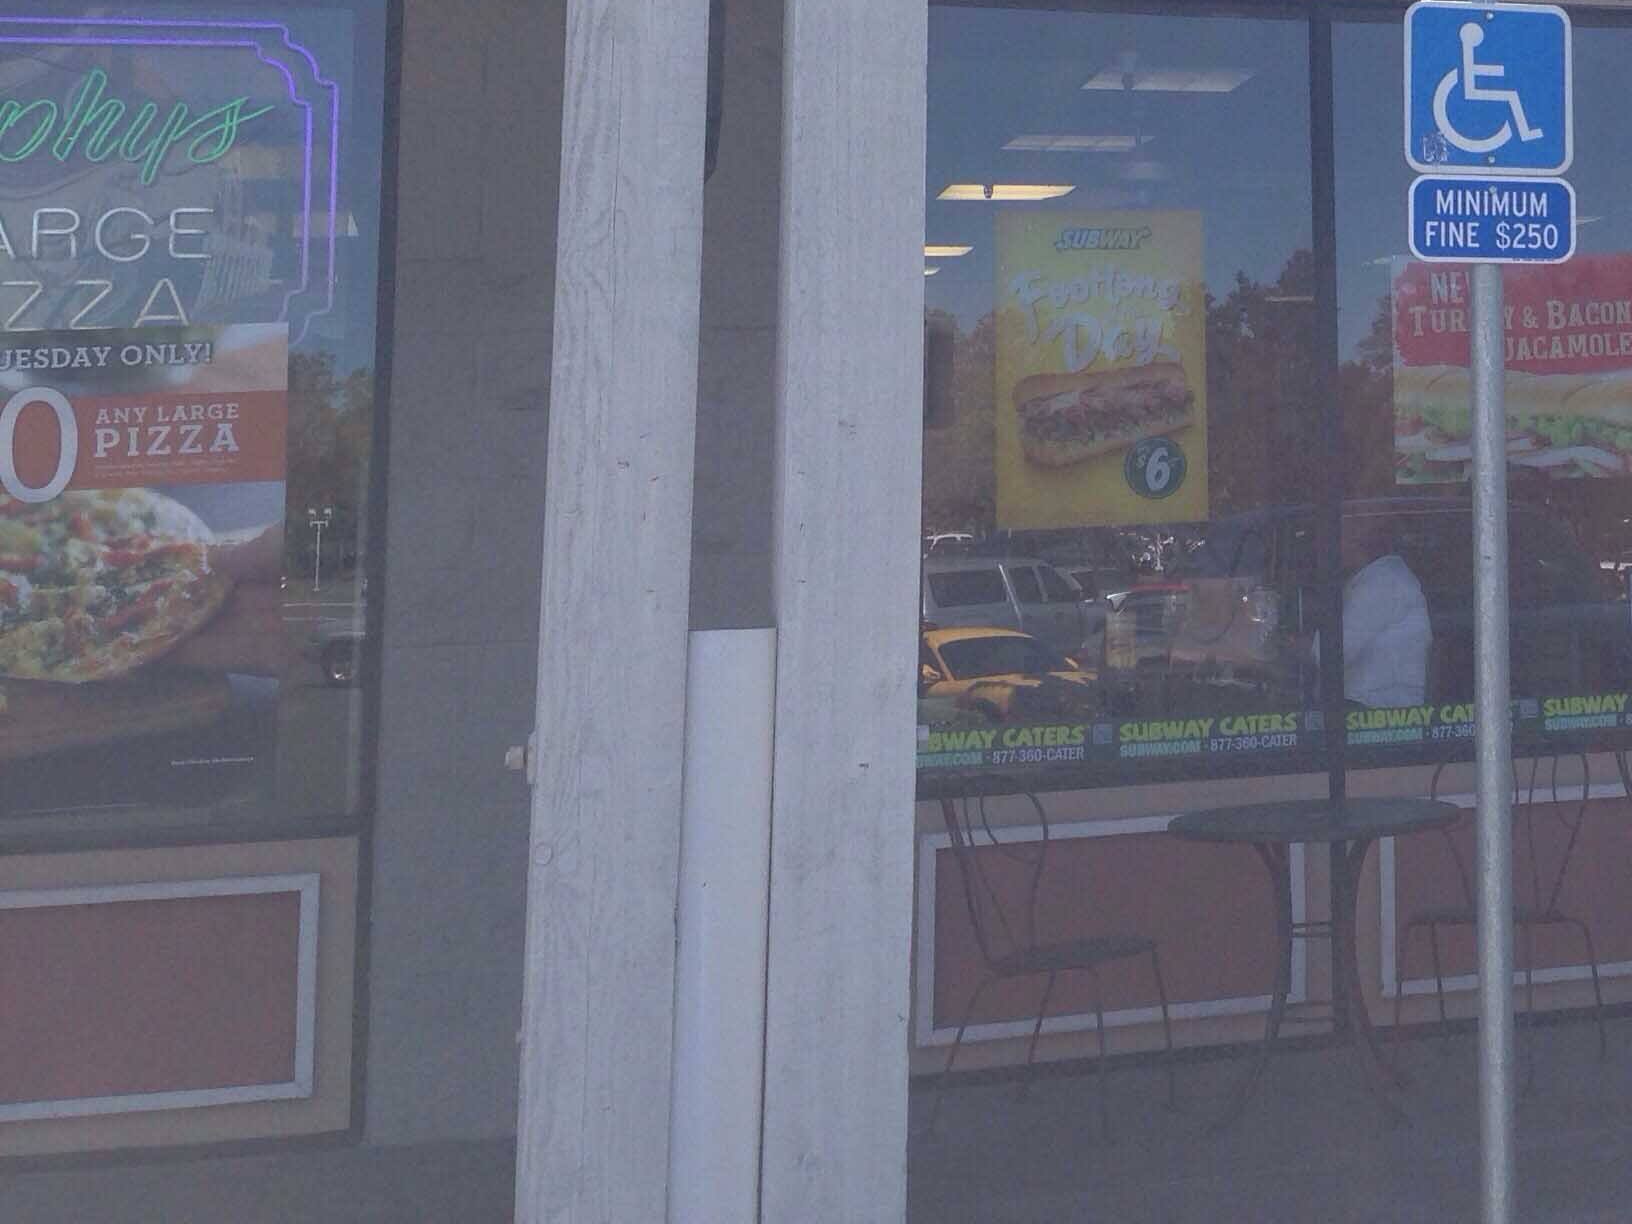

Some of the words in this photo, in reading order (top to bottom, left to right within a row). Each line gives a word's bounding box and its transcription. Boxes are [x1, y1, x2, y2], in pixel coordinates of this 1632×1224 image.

[1435, 188, 1548, 218] MINIMUM
[1054, 225, 1152, 253] SUBWAY
[1424, 221, 1480, 249] FINE
[1496, 222, 1559, 251] $250
[1429, 271, 1471, 305] NE
[1408, 304, 1516, 337] TURY
[1520, 306, 1539, 329] &
[1546, 299, 1632, 329] BACON
[120, 342, 212, 366] ONLY!
[95, 407, 147, 424] ANY
[157, 403, 239, 422] LARGE
[93, 423, 239, 458] PIZZA
[1346, 705, 1435, 731] SUBWAY
[1543, 693, 1628, 717] SUBWAY
[1003, 724, 1086, 747] CATERS
[1120, 717, 1214, 743] SUBWAY
[1219, 712, 1298, 736] CATERS
